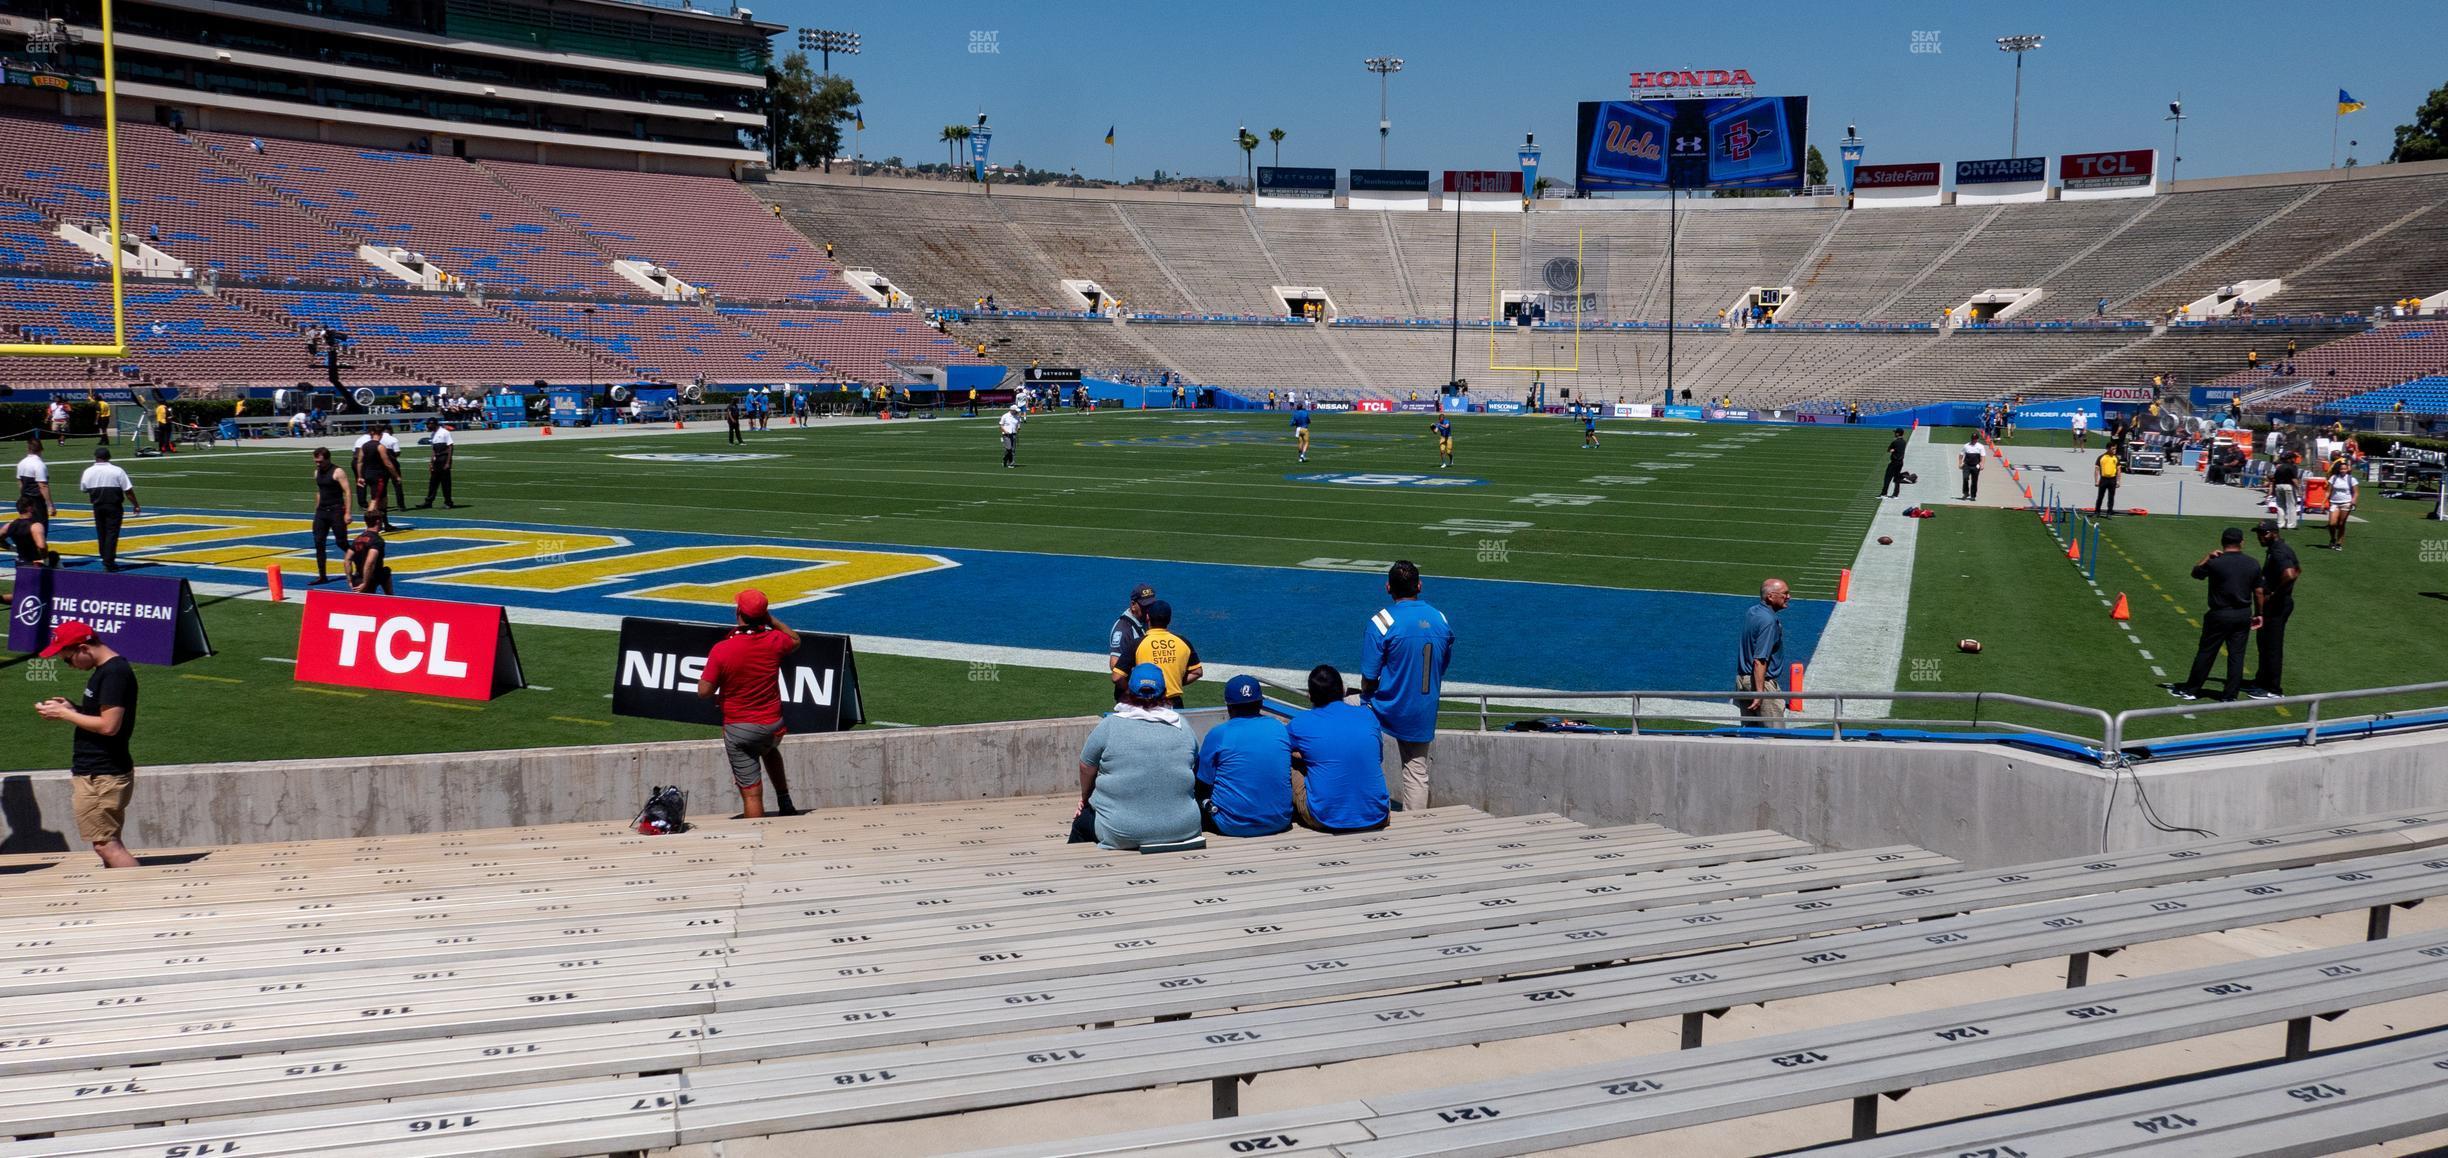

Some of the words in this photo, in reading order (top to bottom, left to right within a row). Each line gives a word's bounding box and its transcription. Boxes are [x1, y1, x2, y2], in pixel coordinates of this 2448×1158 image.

[1629, 69, 1756, 88] HONDA
[2076, 155, 2135, 175] TCL
[1762, 290, 1778, 304] 40
[2103, 389, 2151, 399] HONDA
[1363, 402, 1387, 411] TCL
[2060, 411, 2098, 419] ARMUR
[52, 597, 77, 612] THE
[81, 600, 131, 616] COFFEE
[135, 604, 172, 620] BEAN
[328, 612, 468, 678] TCL
[1151, 639, 1176, 650] CSC
[1152, 649, 1177, 658] EVENT
[1153, 656, 1177, 665] STAFF
[1422, 642, 1433, 695] 1
[622, 649, 834, 707] NISN
[1897, 888, 1936, 897] 126
[2244, 885, 2284, 895] 128
[1479, 898, 1518, 906] 123
[1363, 911, 1403, 919] 122
[1682, 915, 1724, 925] 124
[956, 923, 995, 931] 119
[2043, 915, 2085, 928] 126
[1243, 925, 1283, 934] 121
[1564, 930, 1608, 940] 123
[831, 935, 873, 944] 118
[1115, 939, 1158, 949] 120
[1925, 932, 1970, 945] 125
[699, 947, 740, 957] 117
[979, 952, 1025, 962] 119
[1437, 946, 1482, 956] 122
[560, 960, 602, 968] 116
[1801, 951, 1848, 965] 124
[23, 966, 66, 975] 112
[837, 966, 884, 976] 118
[1304, 960, 1349, 971] 121
[2317, 963, 2363, 977] 127
[414, 971, 456, 980] 115
[1670, 972, 1718, 985] 123
[261, 983, 304, 993] 114
[688, 980, 737, 991] 117
[1159, 976, 1207, 988] 120
[2203, 982, 2253, 995] 126
[98, 996, 146, 1006] 113
[528, 992, 580, 1003] 116
[1004, 993, 1055, 1004] 119
[1523, 989, 1576, 1002] 122
[362, 1006, 415, 1017] 115
[843, 1010, 896, 1022] 118
[1375, 1009, 1425, 1022] 121
[2066, 1004, 2118, 1019] 125
[668, 1026, 723, 1039] 117
[1205, 1031, 1262, 1044] 120
[1936, 1025, 1991, 1042] 124
[483, 1044, 541, 1056] 116
[1026, 1049, 1086, 1063] 119
[1771, 1051, 1829, 1067] 123
[285, 1063, 348, 1076] 115
[833, 1070, 897, 1085] 118
[76, 1083, 148, 1097] 114
[1601, 1079, 1665, 1096] 122
[2287, 1082, 2347, 1102] 125
[630, 1094, 697, 1110] 117
[1437, 1106, 1501, 1123] 121
[409, 1116, 481, 1132] 116
[2133, 1114, 2198, 1134] 124
[1230, 1134, 1299, 1152] 120
[165, 1141, 241, 1158] 115
[1959, 1144, 2028, 1158] 123
